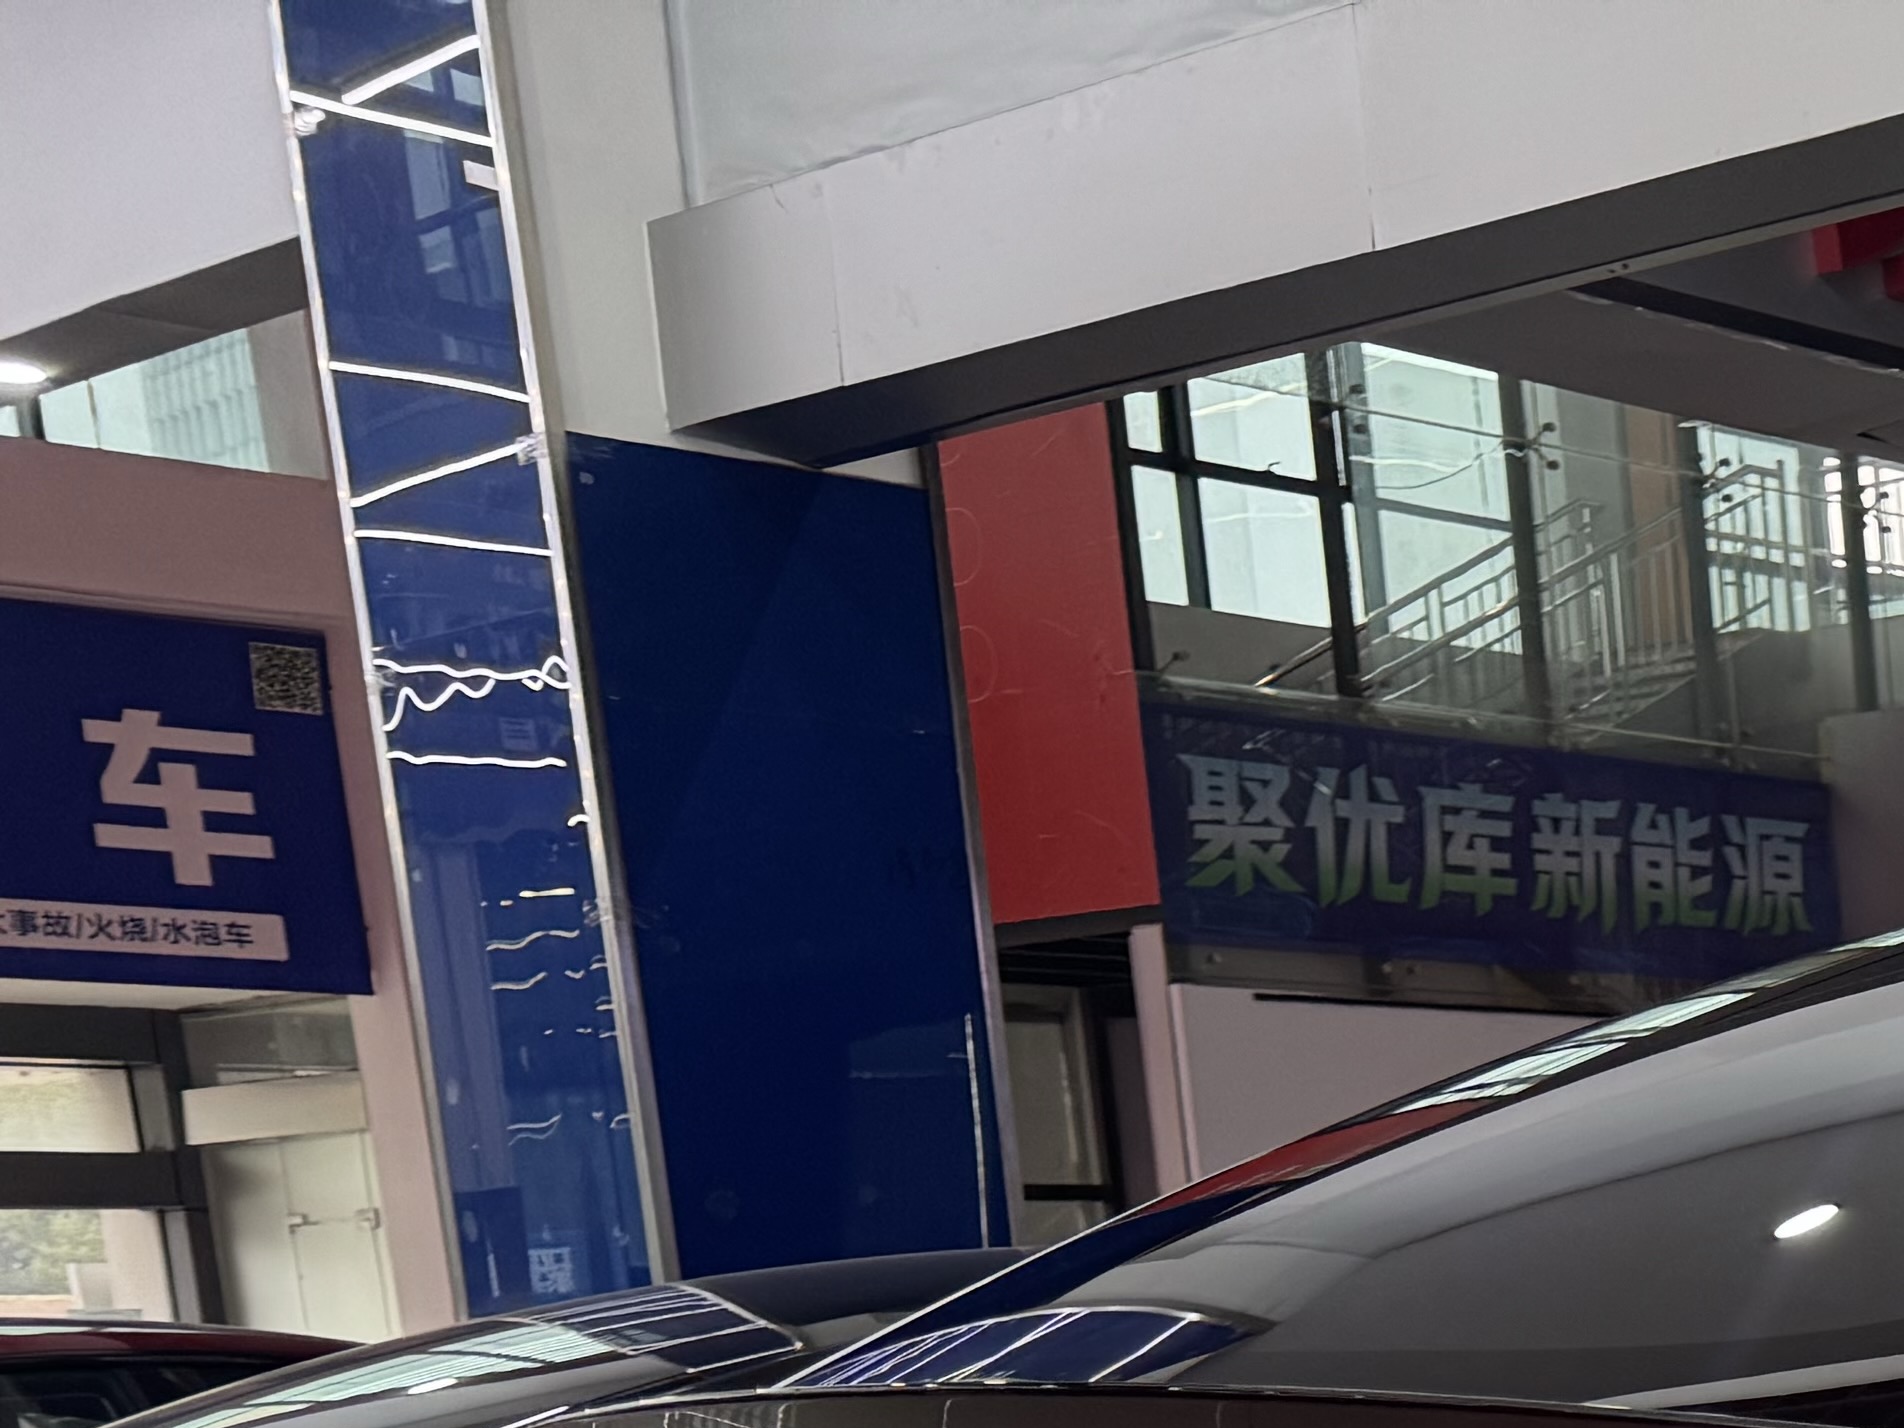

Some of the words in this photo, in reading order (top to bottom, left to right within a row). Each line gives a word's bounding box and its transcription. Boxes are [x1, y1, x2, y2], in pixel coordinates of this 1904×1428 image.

[82, 708, 275, 886] 车
[1178, 752, 1814, 937] 聚优库新能源
[0, 908, 254, 948] 事故/火烧/水泡车
